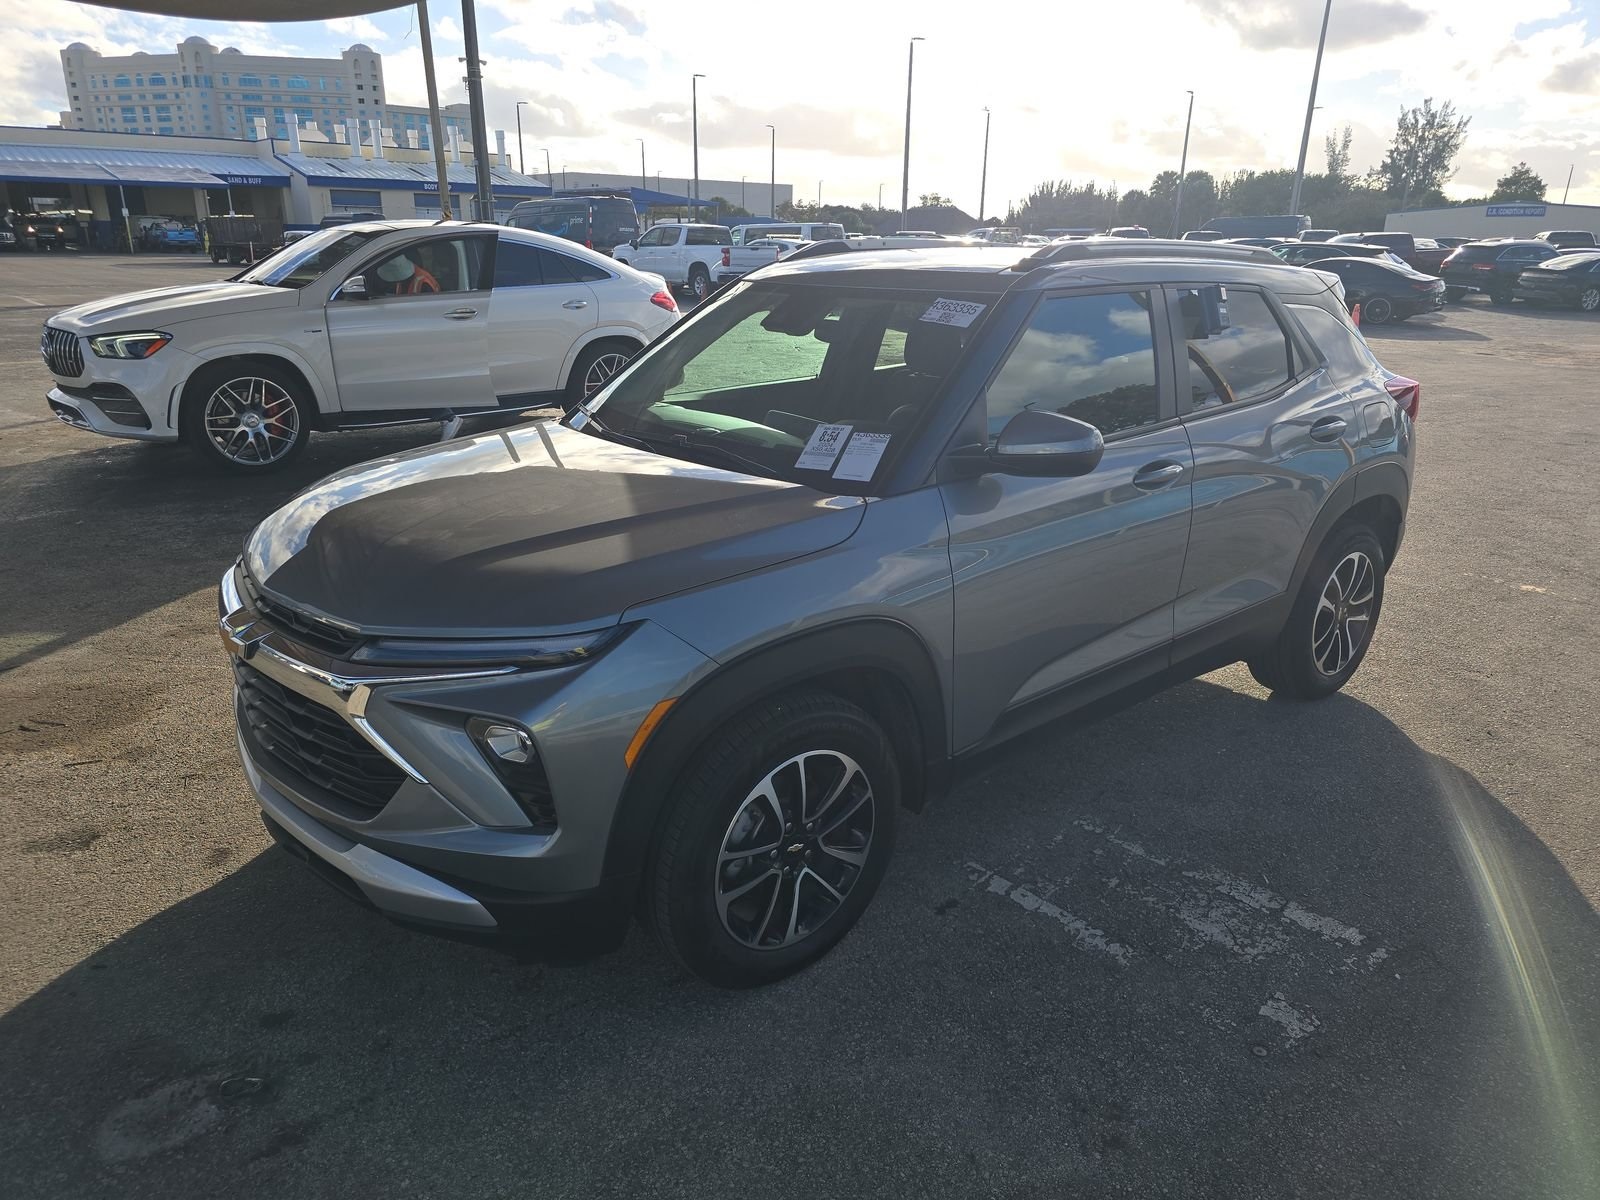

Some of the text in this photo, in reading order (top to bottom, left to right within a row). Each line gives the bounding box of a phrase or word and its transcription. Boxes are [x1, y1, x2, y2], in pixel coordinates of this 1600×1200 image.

[227, 176, 242, 184] SAND
[248, 177, 262, 185] BUFF
[569, 215, 584, 226] prime
[818, 430, 841, 443] 8:54
